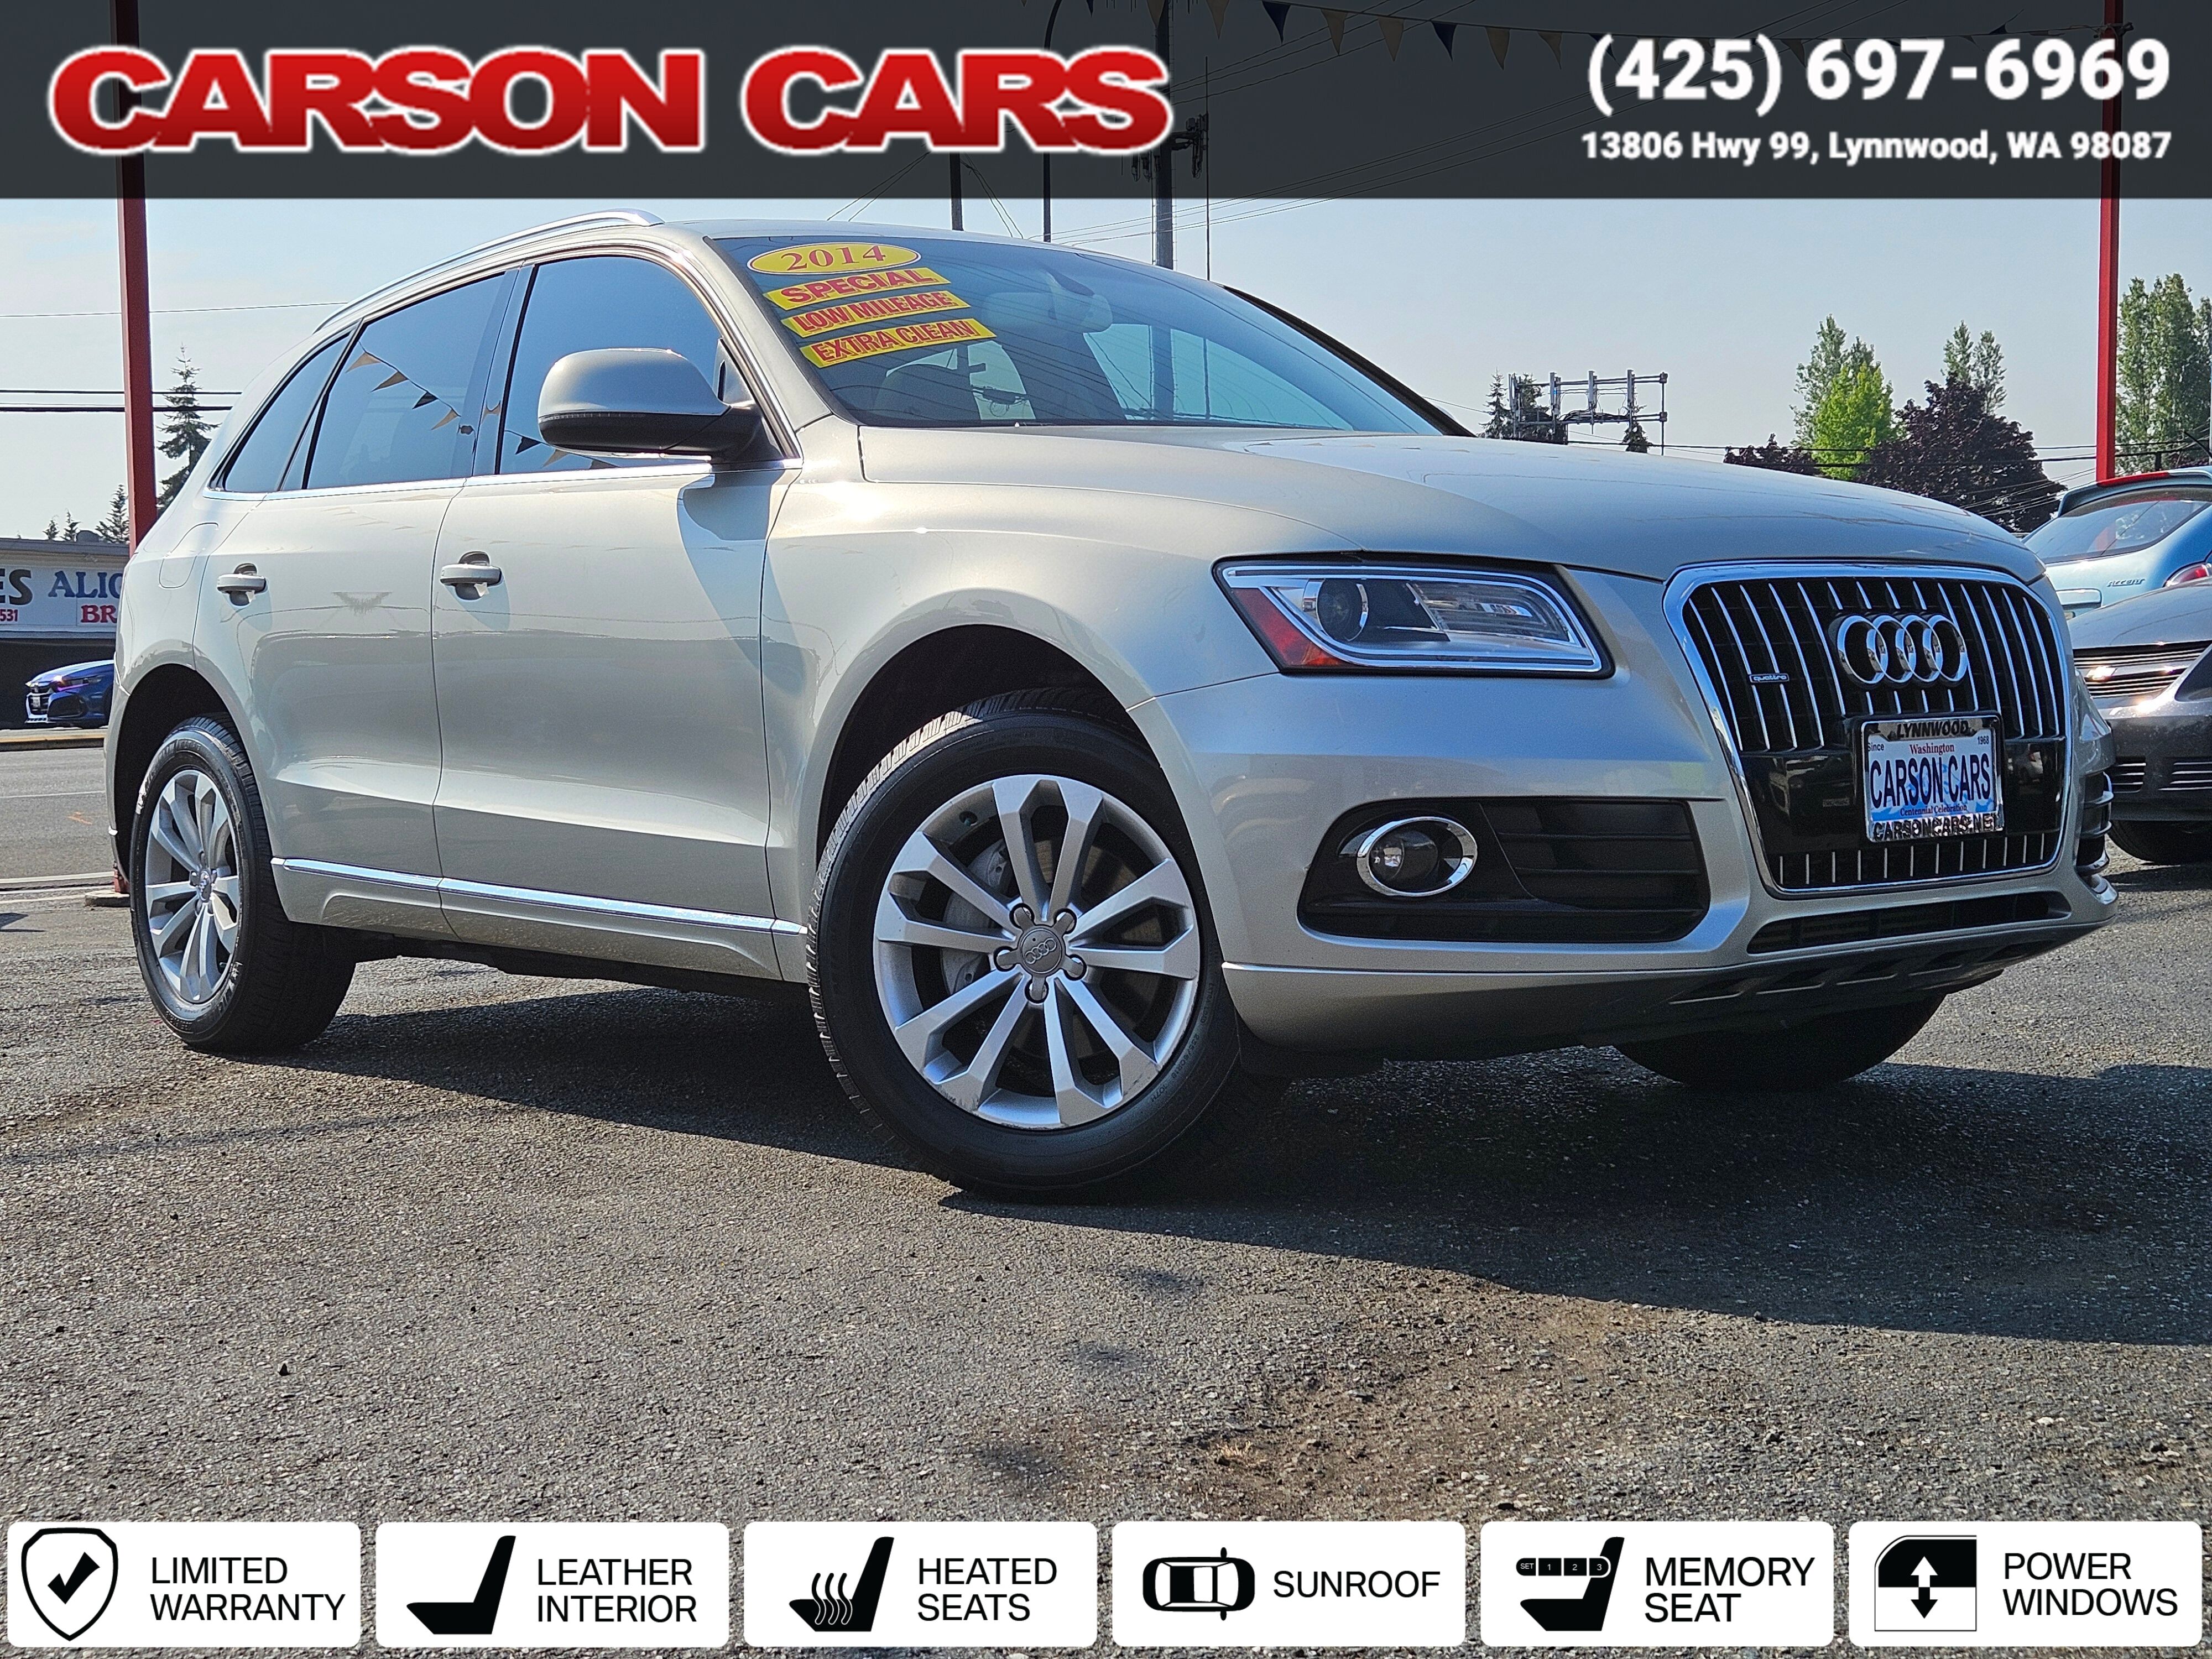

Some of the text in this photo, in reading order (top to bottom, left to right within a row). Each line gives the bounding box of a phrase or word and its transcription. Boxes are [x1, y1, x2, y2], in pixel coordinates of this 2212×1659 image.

[781, 246, 885, 271] 2014
[781, 269, 938, 304] SPECIAL
[792, 290, 957, 332] LOW MILEAGE
[811, 320, 980, 362] EXTRA CLEAN
[0, 568, 33, 606] S
[1896, 719, 1969, 739] LYNNWOOD
[1909, 742, 1955, 755] Washington
[1870, 753, 1991, 809] CARSON CARS
[1900, 803, 1967, 816] Centennial Celebration
